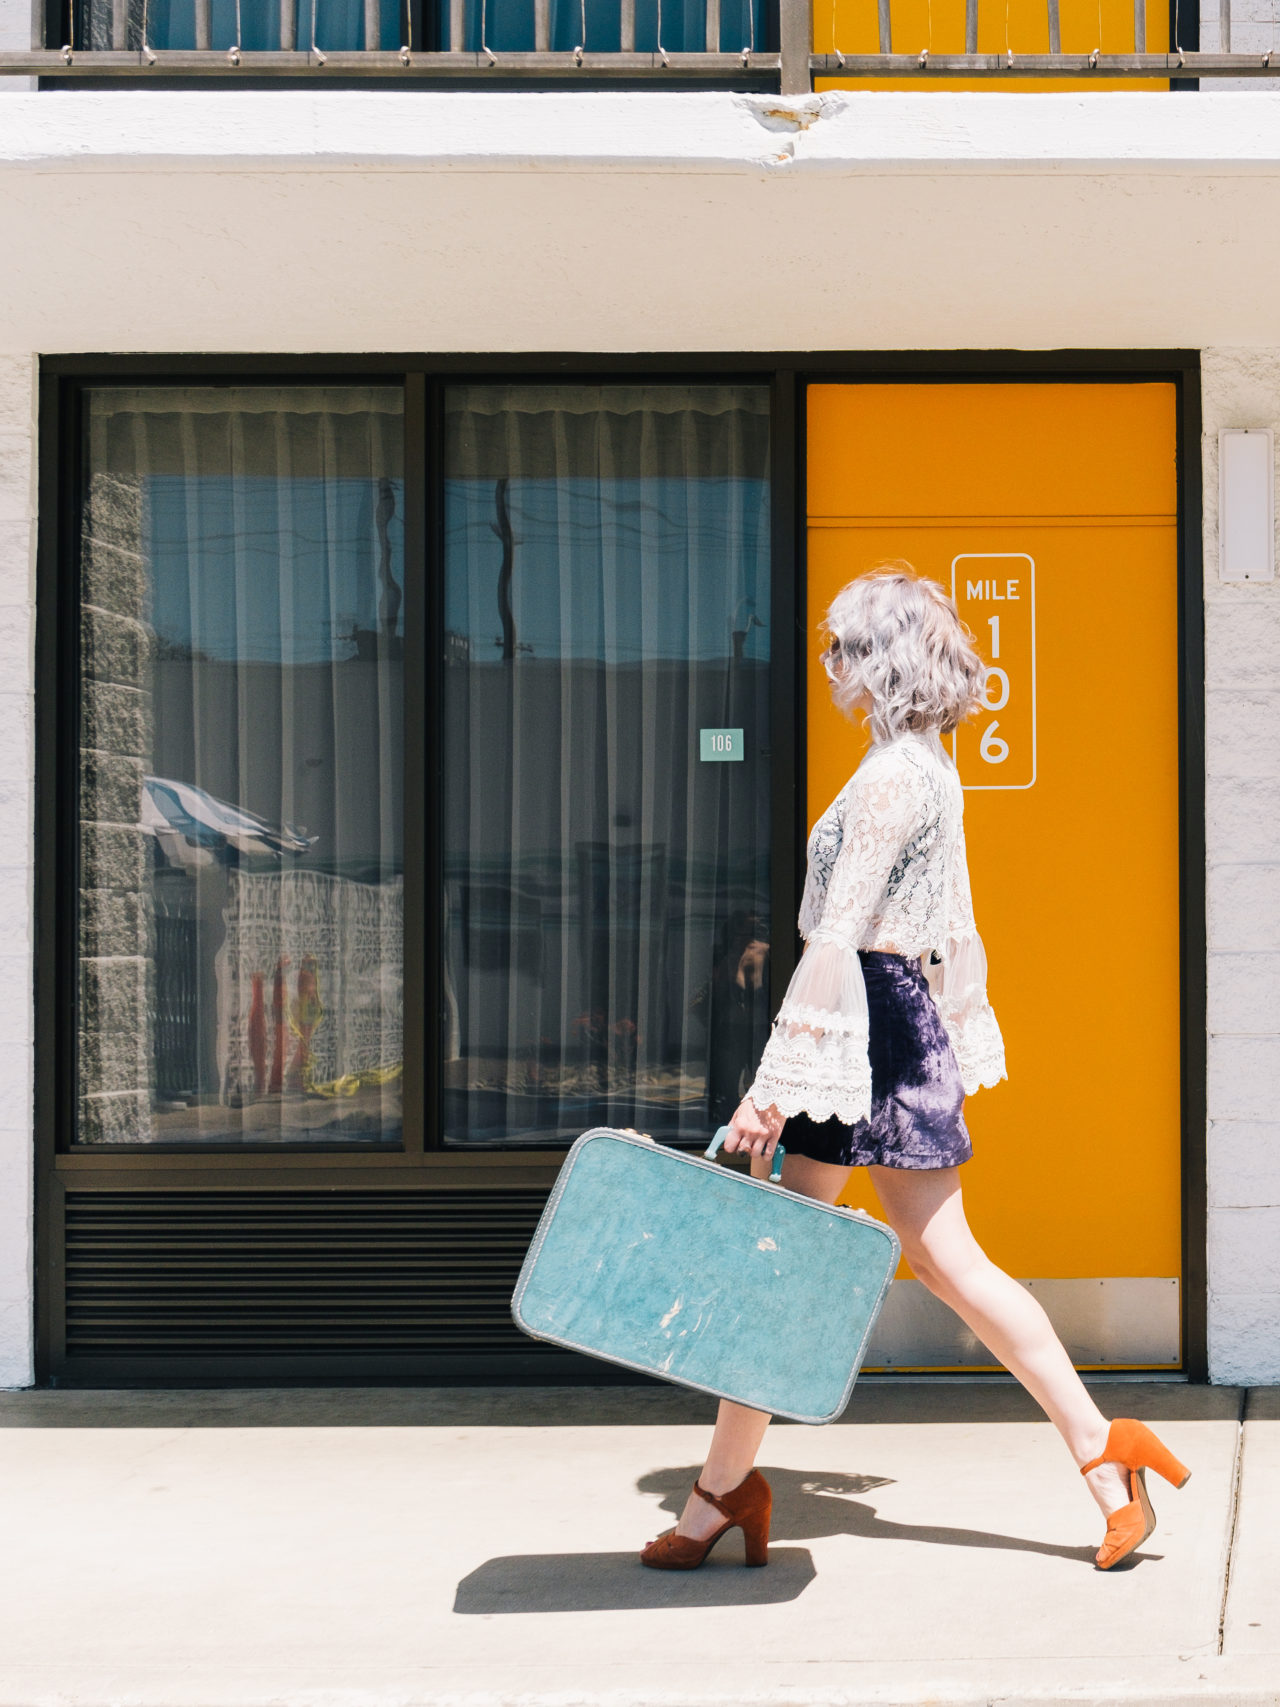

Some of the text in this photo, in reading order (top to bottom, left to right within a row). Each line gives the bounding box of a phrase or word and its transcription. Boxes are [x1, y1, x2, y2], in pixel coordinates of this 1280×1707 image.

[966, 579, 1020, 601] MILE
[979, 615, 1010, 764] 106
[711, 734, 732, 752] 106
